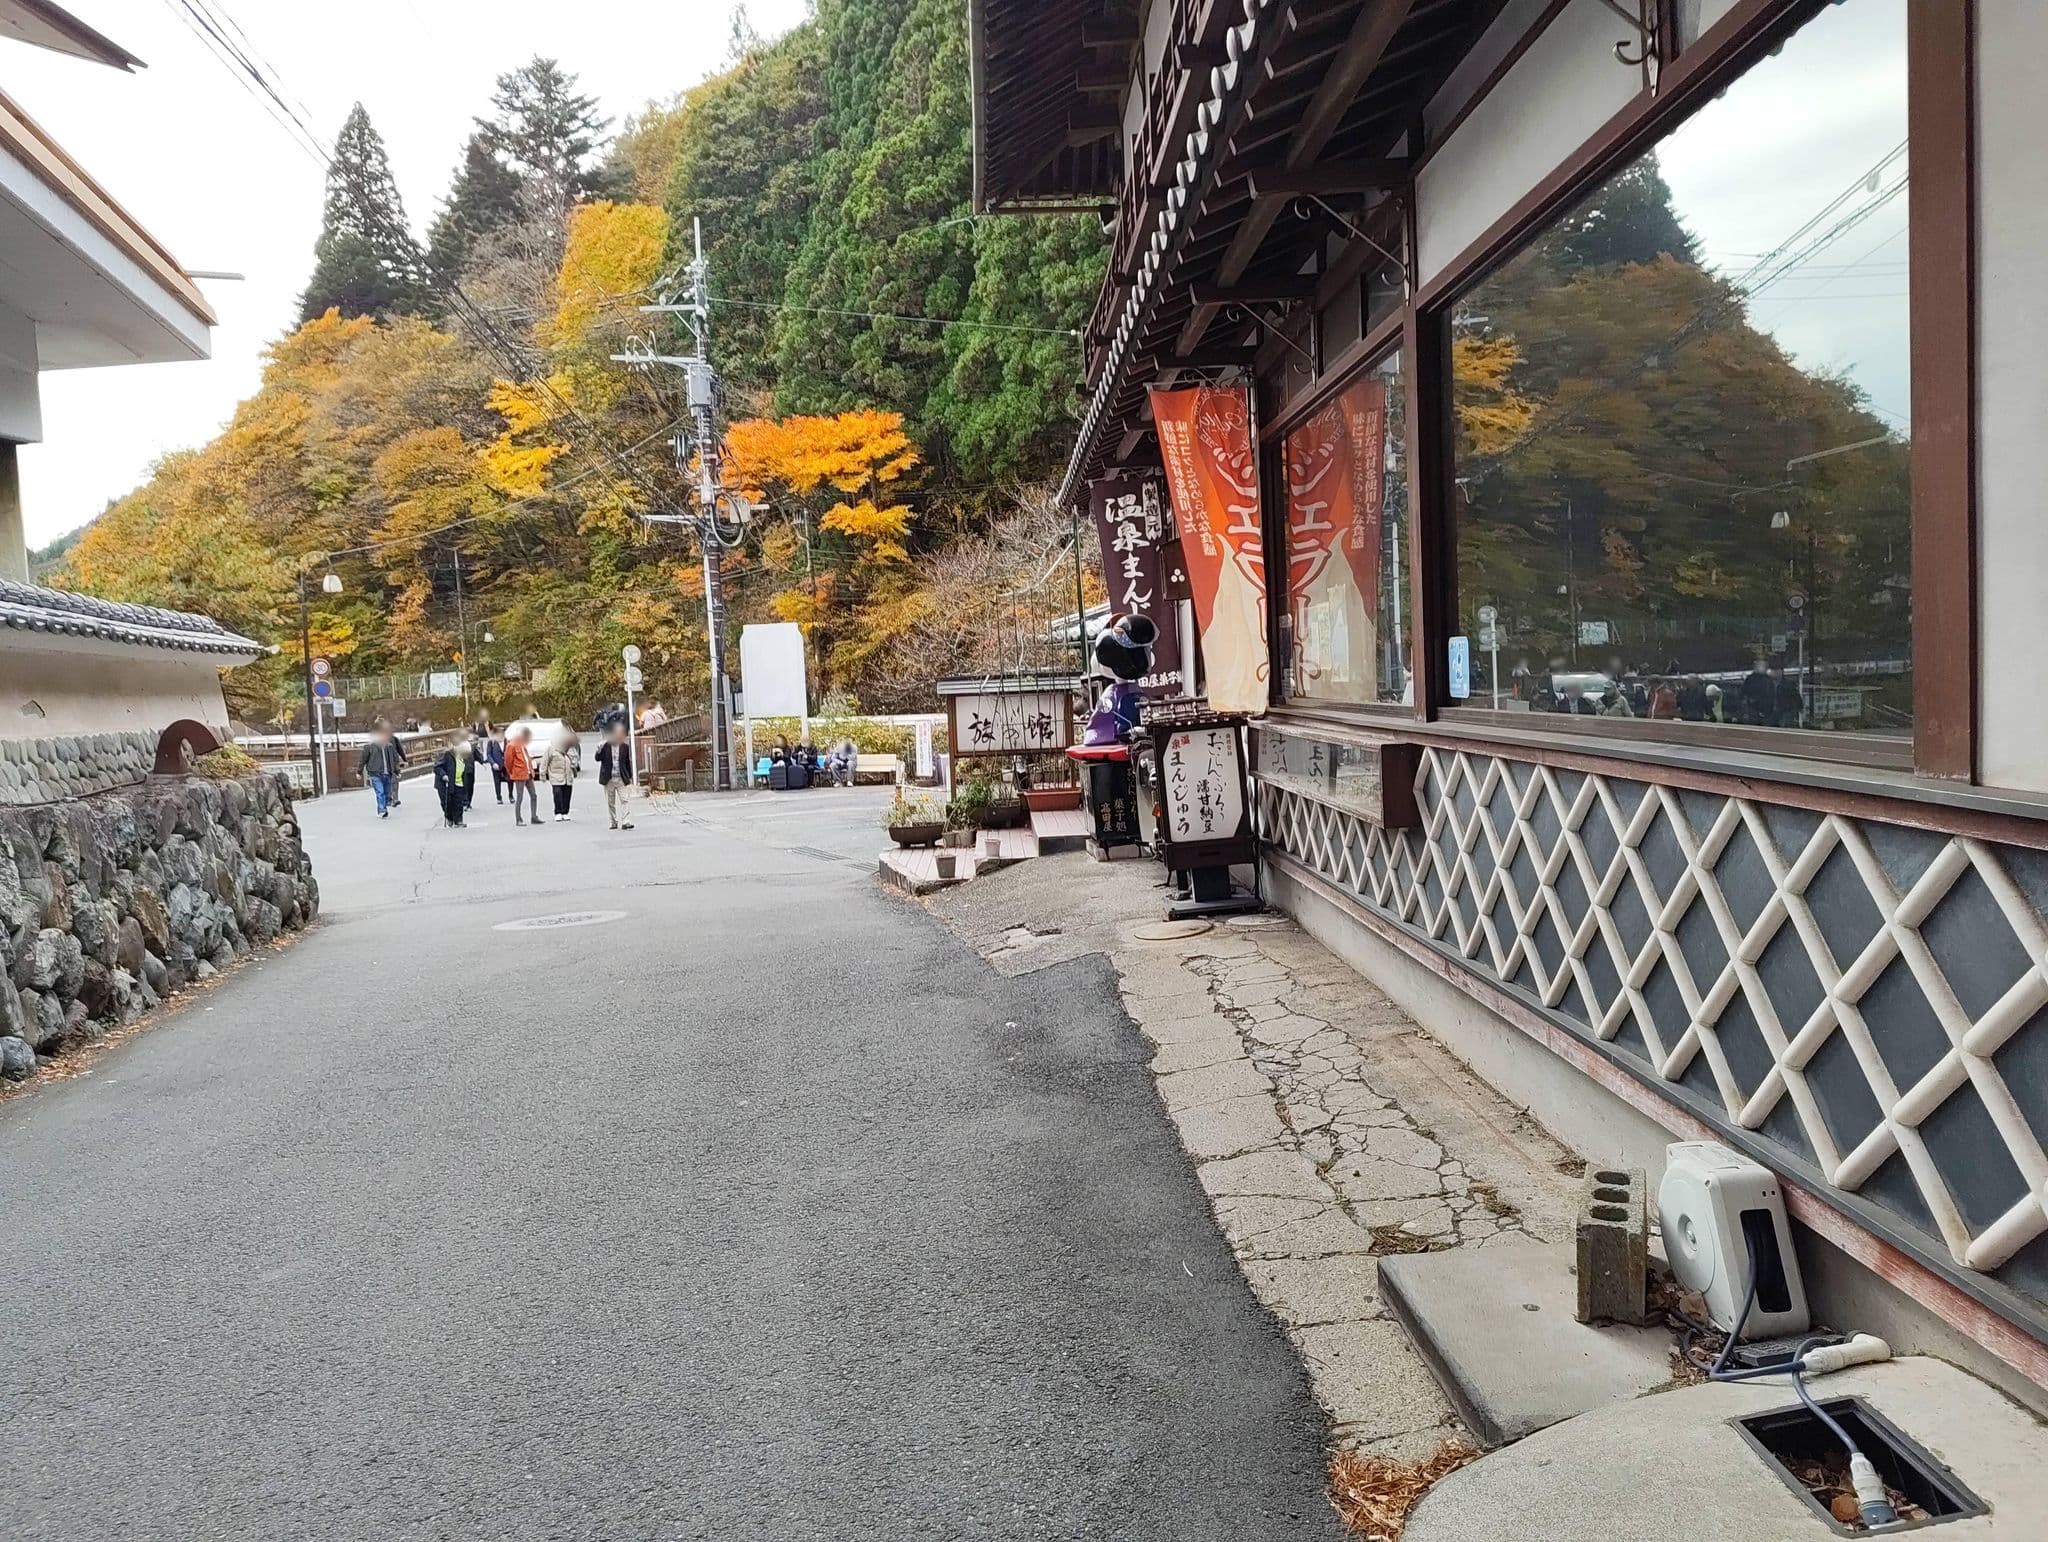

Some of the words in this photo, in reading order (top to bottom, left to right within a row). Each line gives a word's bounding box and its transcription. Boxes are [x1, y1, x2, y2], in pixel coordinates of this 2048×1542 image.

[1170, 751, 1189, 835] まんじゅう
